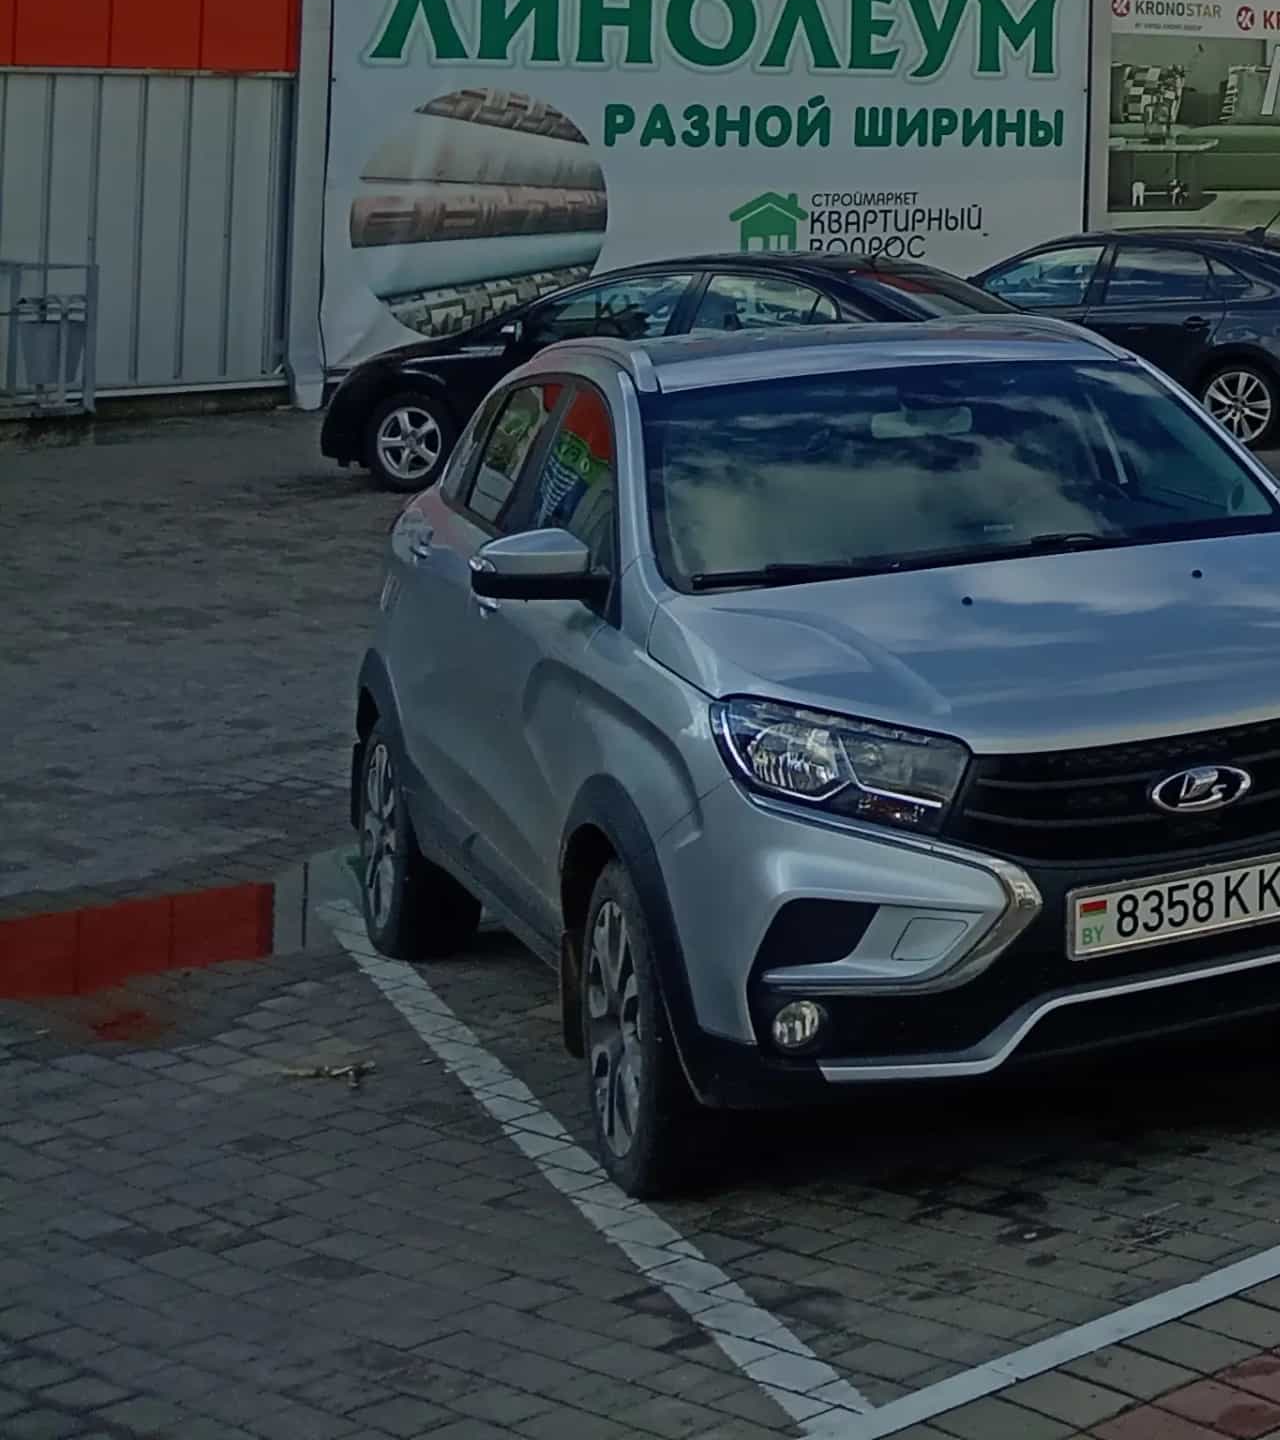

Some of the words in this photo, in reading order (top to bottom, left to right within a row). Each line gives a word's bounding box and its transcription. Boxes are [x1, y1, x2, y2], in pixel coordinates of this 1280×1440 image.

[1135, 0, 1222, 18] KRONOSTAR
[603, 95, 832, 148] РАЗНОЙ
[854, 103, 1064, 148] ШИРИНЫ
[811, 191, 918, 207] СТРОЙМАРКЕТ
[810, 204, 983, 235] КВАРТИРНЫЙ
[1082, 926, 1104, 945] BY
[1116, 880, 1214, 938] 8358
